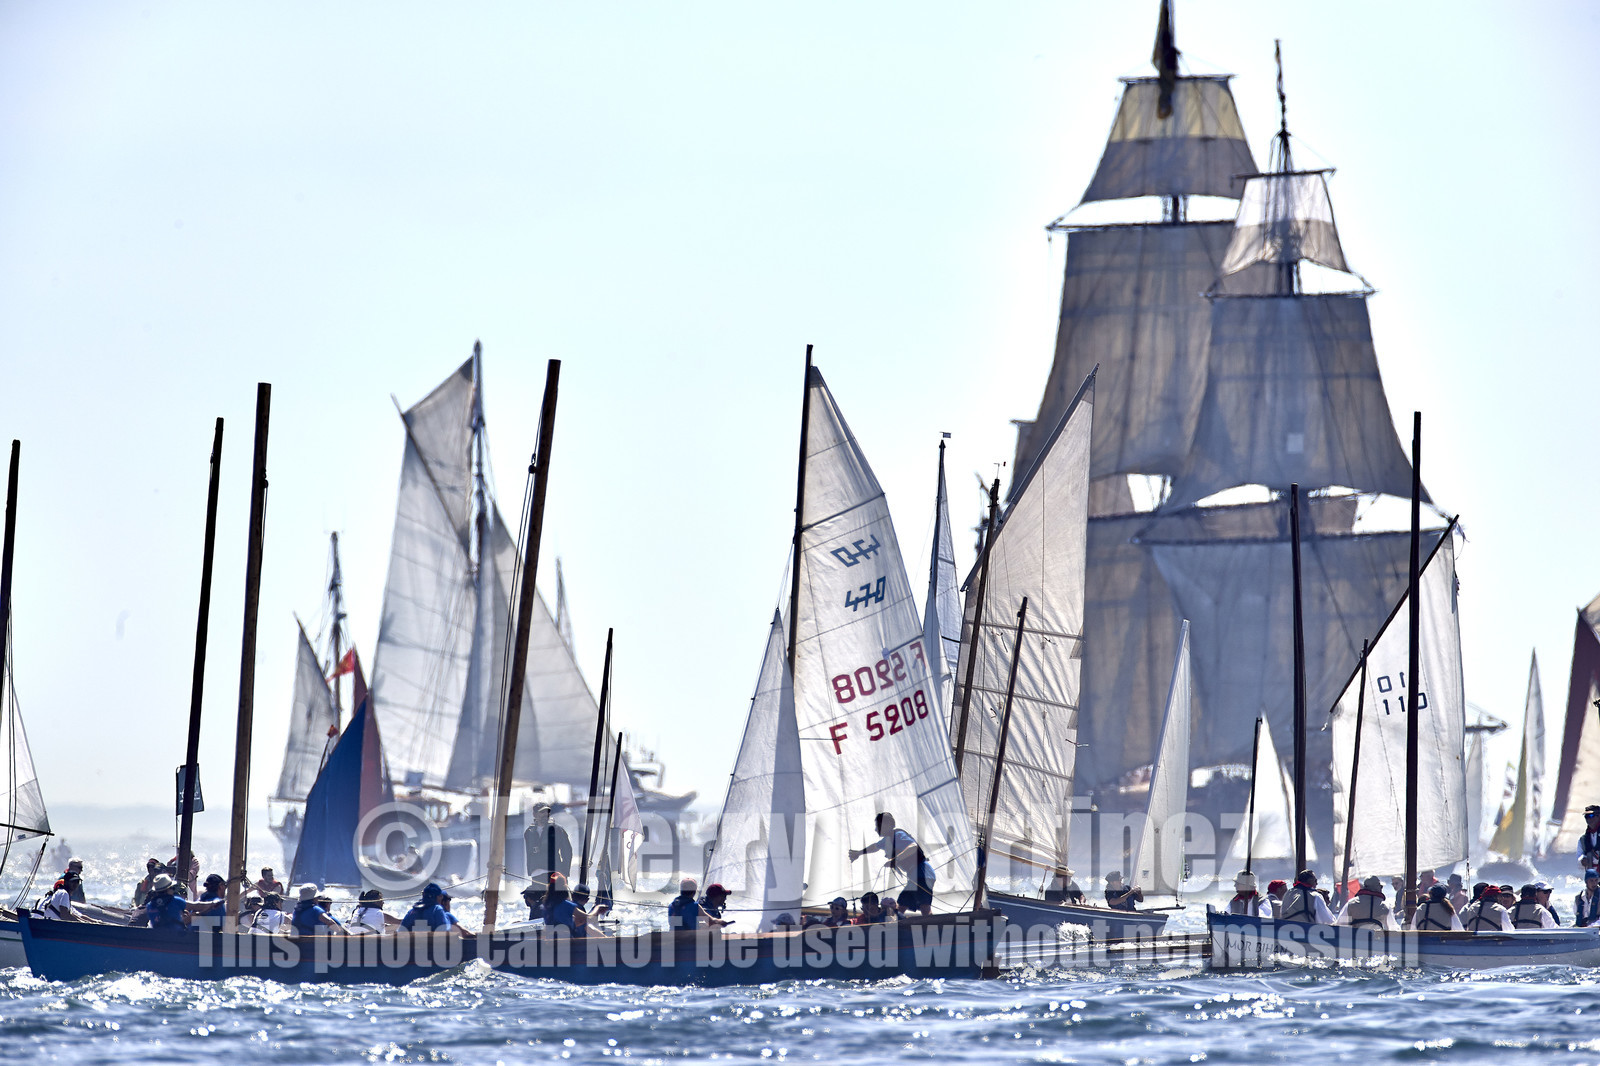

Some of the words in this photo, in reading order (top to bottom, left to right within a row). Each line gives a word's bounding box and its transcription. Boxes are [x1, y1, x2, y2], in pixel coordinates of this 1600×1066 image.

[845, 576, 886, 612] 470
[829, 722, 848, 755] F
[866, 690, 929, 741] 5208
[1226, 938, 1252, 952] MOR
